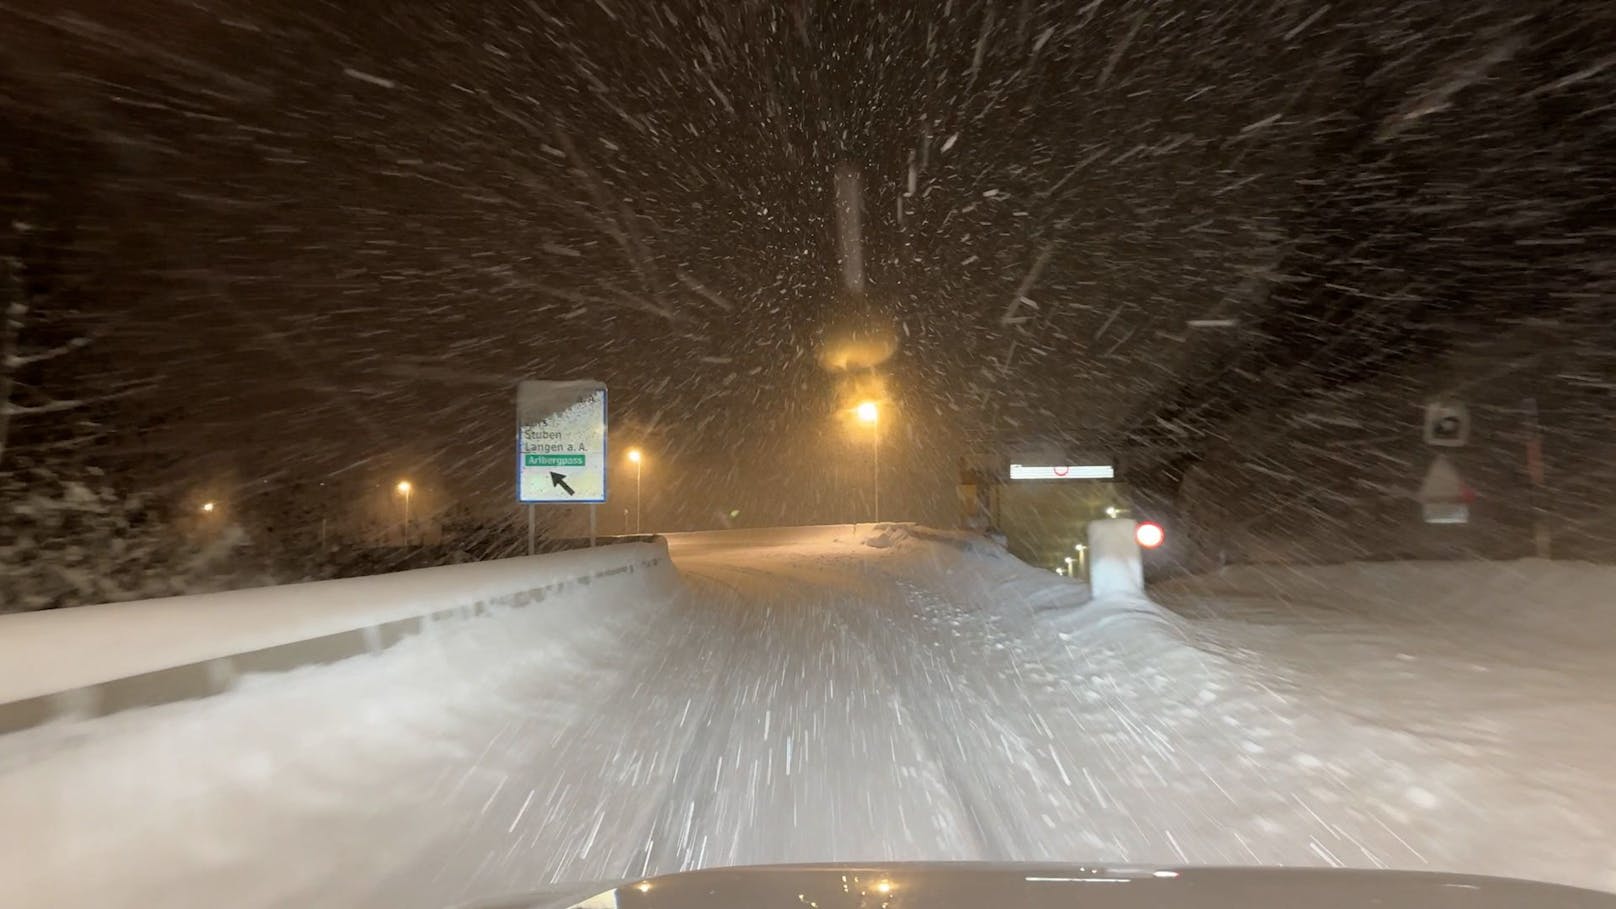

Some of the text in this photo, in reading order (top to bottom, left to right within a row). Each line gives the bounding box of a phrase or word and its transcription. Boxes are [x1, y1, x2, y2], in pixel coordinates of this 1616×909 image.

[525, 430, 562, 440] Stuben
[525, 442, 588, 453] Langen a. A.
[529, 456, 583, 465] Arlbergpass
